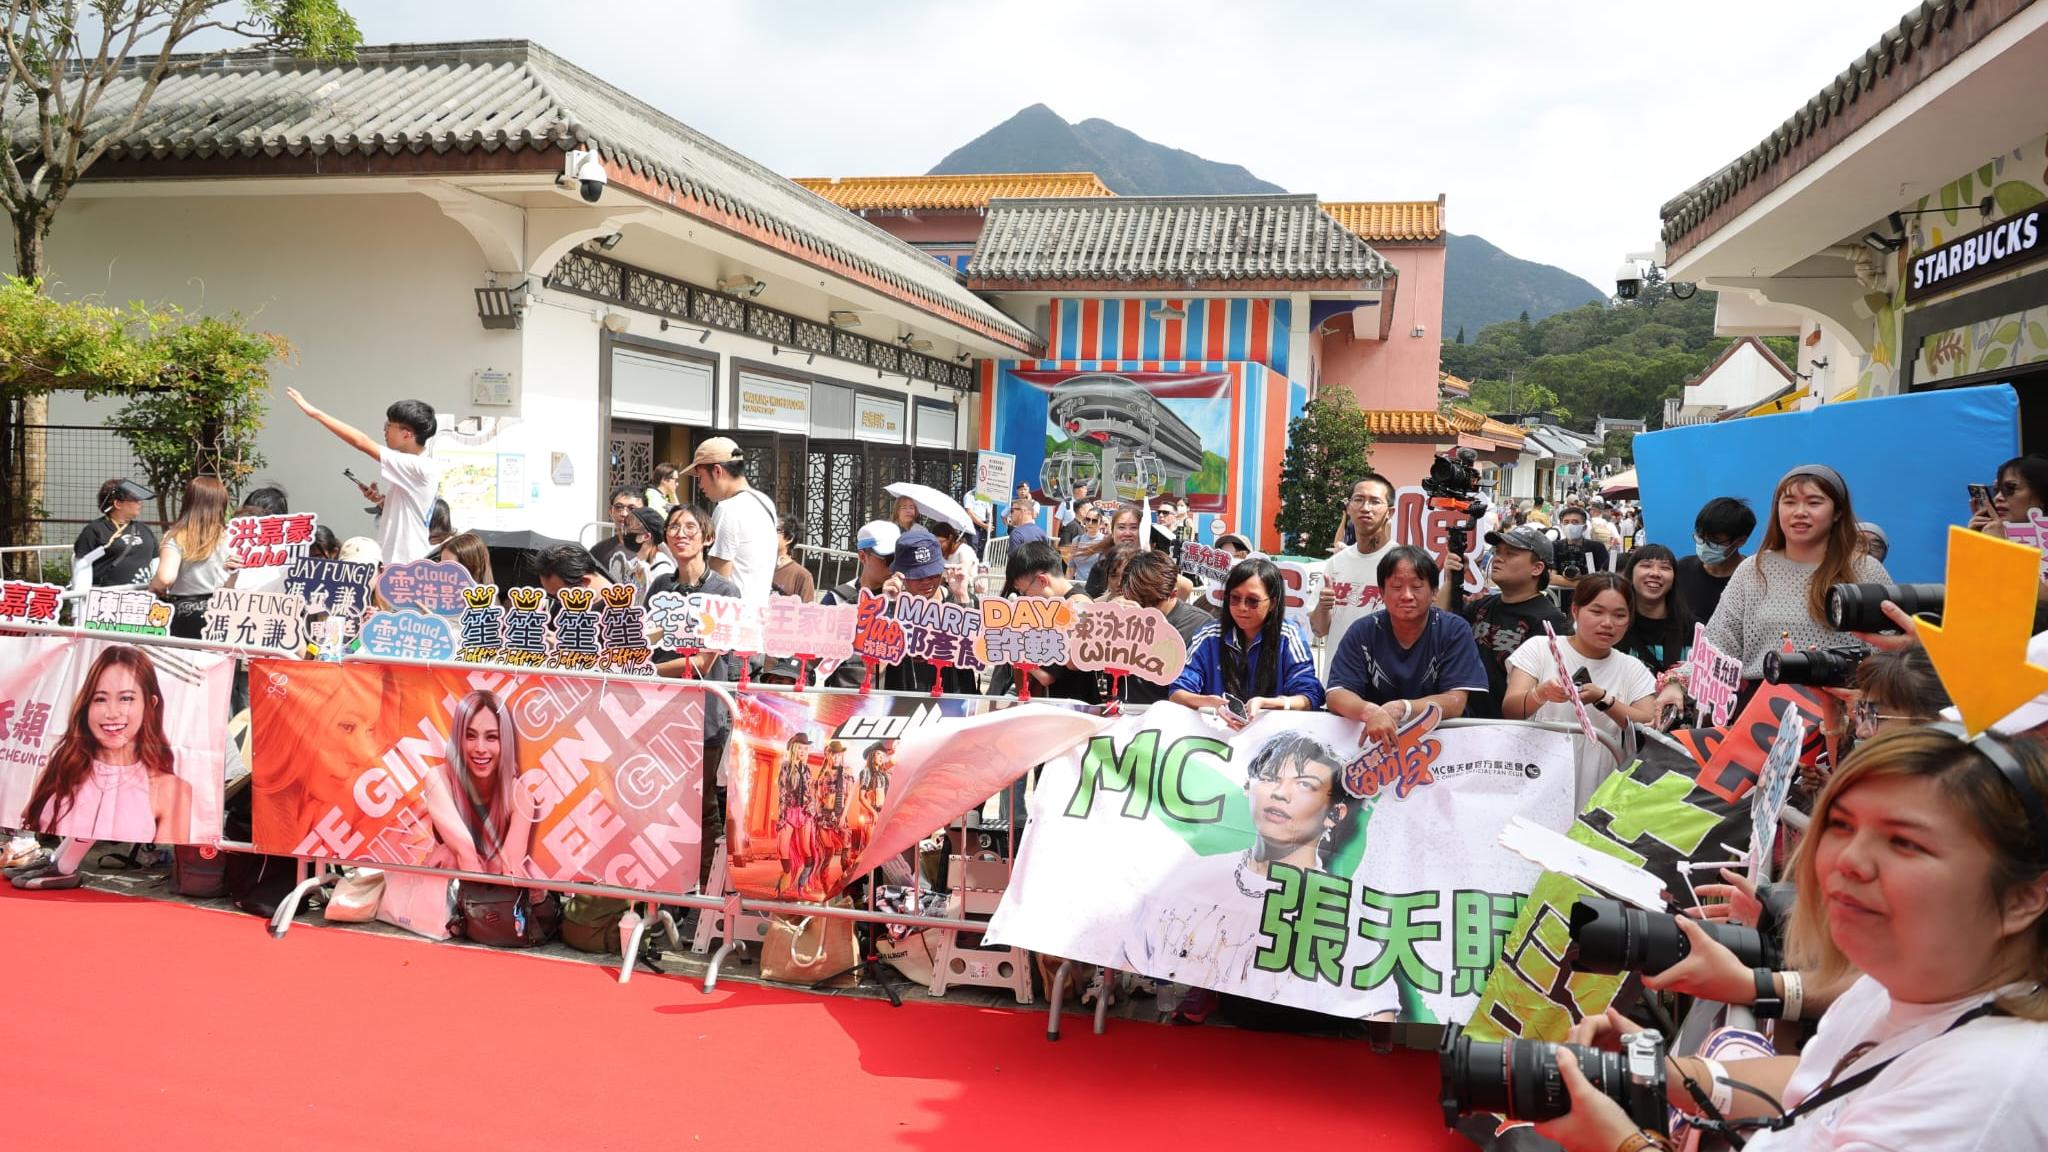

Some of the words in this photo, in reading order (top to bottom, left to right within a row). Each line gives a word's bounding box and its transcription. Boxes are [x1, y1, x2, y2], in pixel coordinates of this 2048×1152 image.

[1914, 213, 2038, 289] STARBUCKS
[229, 515, 315, 548] 洪嘉豪
[290, 559, 321, 579] JAY
[321, 562, 366, 584] FUNG
[415, 566, 458, 585] Cloud
[0, 583, 60, 620] 嘉豪
[86, 590, 152, 625] 陳蕾
[211, 591, 242, 611] JAY
[247, 594, 294, 616] FUNG
[389, 570, 468, 611] 雲浩影
[704, 598, 742, 620] IVY
[898, 595, 981, 637] MARF
[983, 600, 1060, 628] DAY
[205, 615, 288, 648] 馮允謙
[398, 616, 440, 640] Cloud
[461, 608, 502, 648] 笙
[505, 612, 548, 651] 笙
[554, 610, 599, 651] 笙
[602, 607, 647, 648] 笙
[498, 649, 547, 668] Jeffrey
[549, 650, 600, 670] Jeffrey
[599, 648, 650, 670] Jeffrey
[512, 716, 613, 823] GIN
[1063, 729, 1234, 824] MC
